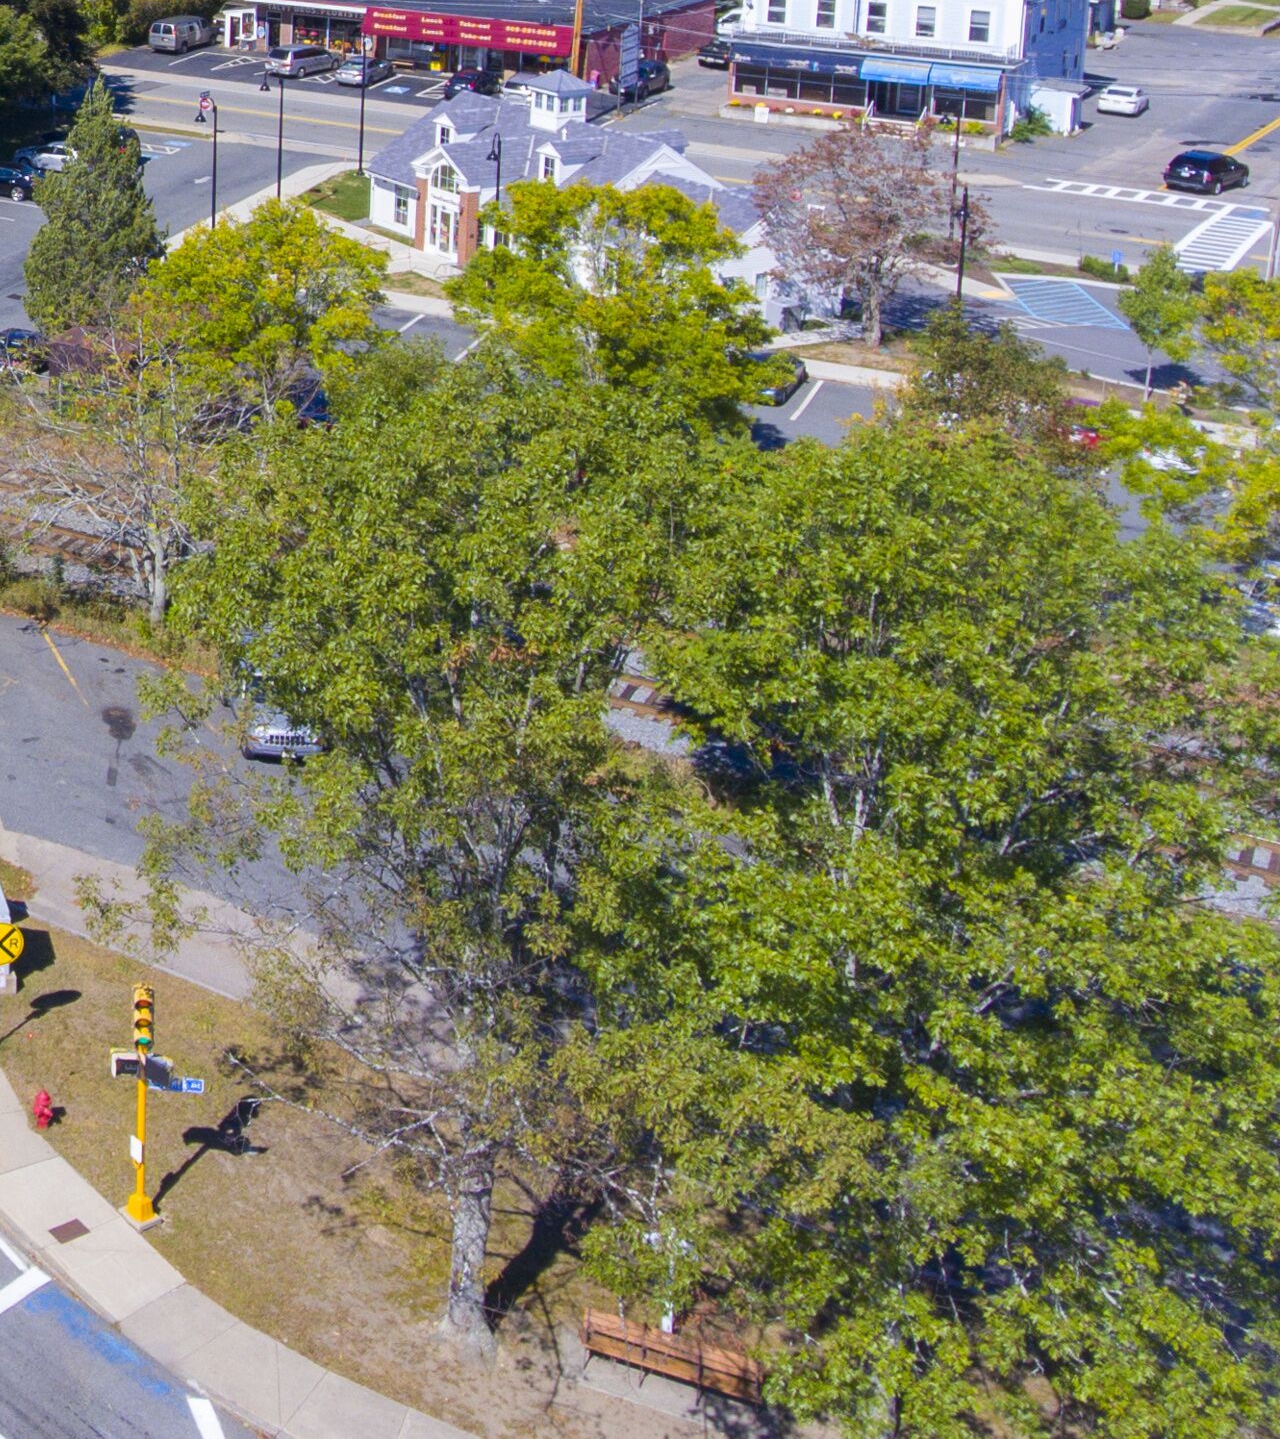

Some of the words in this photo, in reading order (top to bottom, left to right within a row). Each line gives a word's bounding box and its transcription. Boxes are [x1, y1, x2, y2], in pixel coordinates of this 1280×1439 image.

[372, 11, 406, 20] Breakfast
[421, 16, 443, 25] Lunch
[374, 23, 407, 32] Breakfast
[422, 28, 444, 37] Lunch
[9, 938, 19, 948] R
